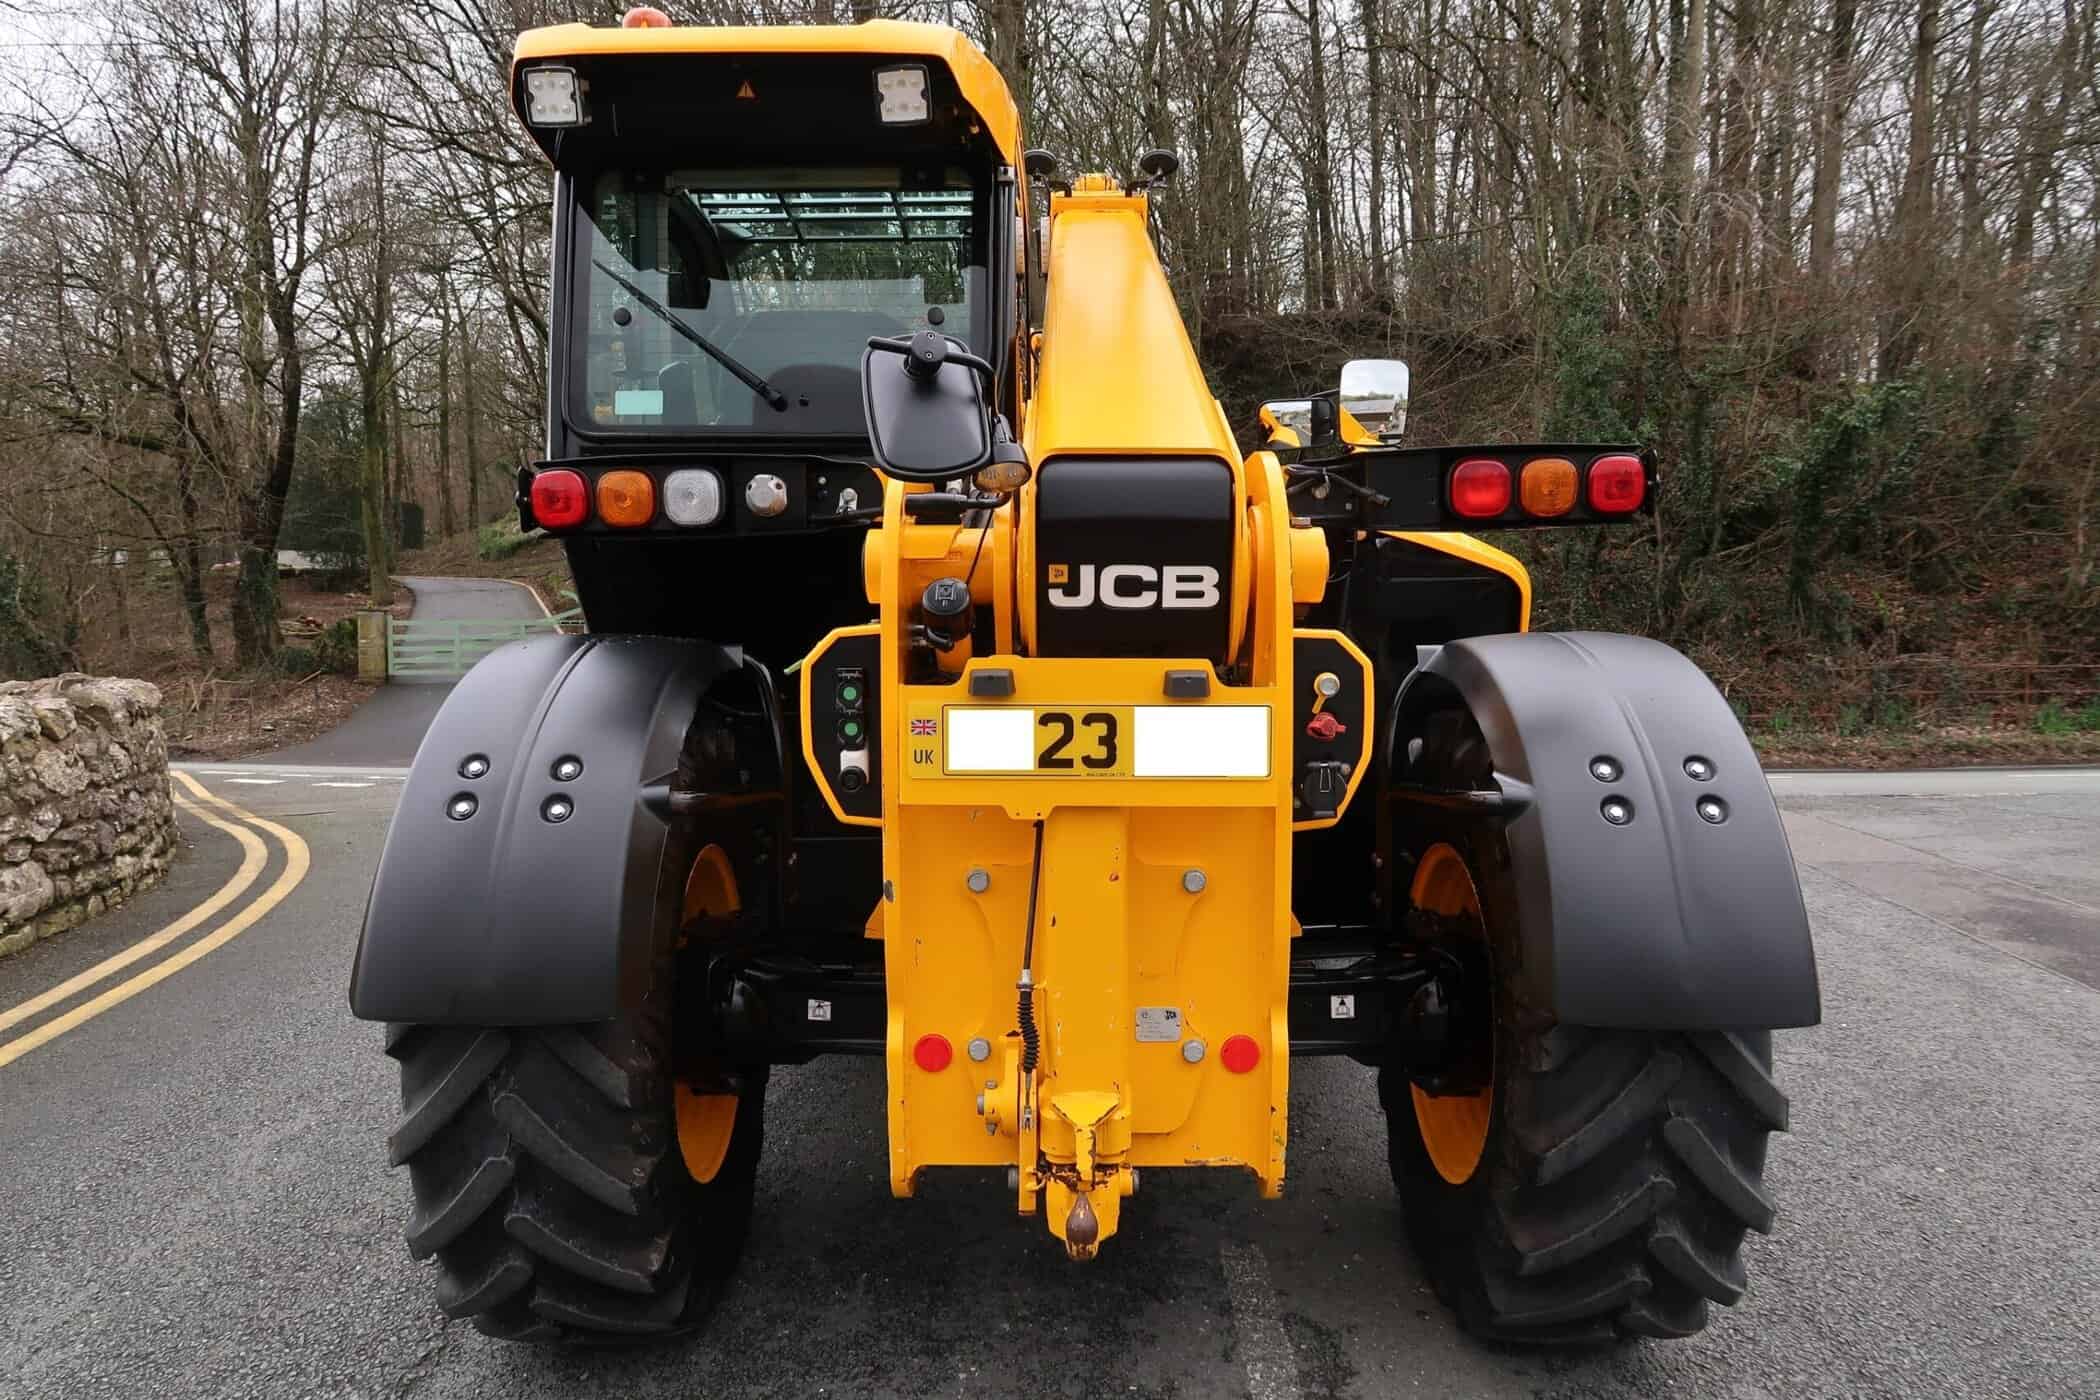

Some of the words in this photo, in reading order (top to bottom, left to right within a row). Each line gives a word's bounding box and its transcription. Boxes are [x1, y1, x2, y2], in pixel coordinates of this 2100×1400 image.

[1048, 564, 1220, 608] JCB
[914, 749, 934, 764] UK
[1038, 712, 1117, 768] 23
